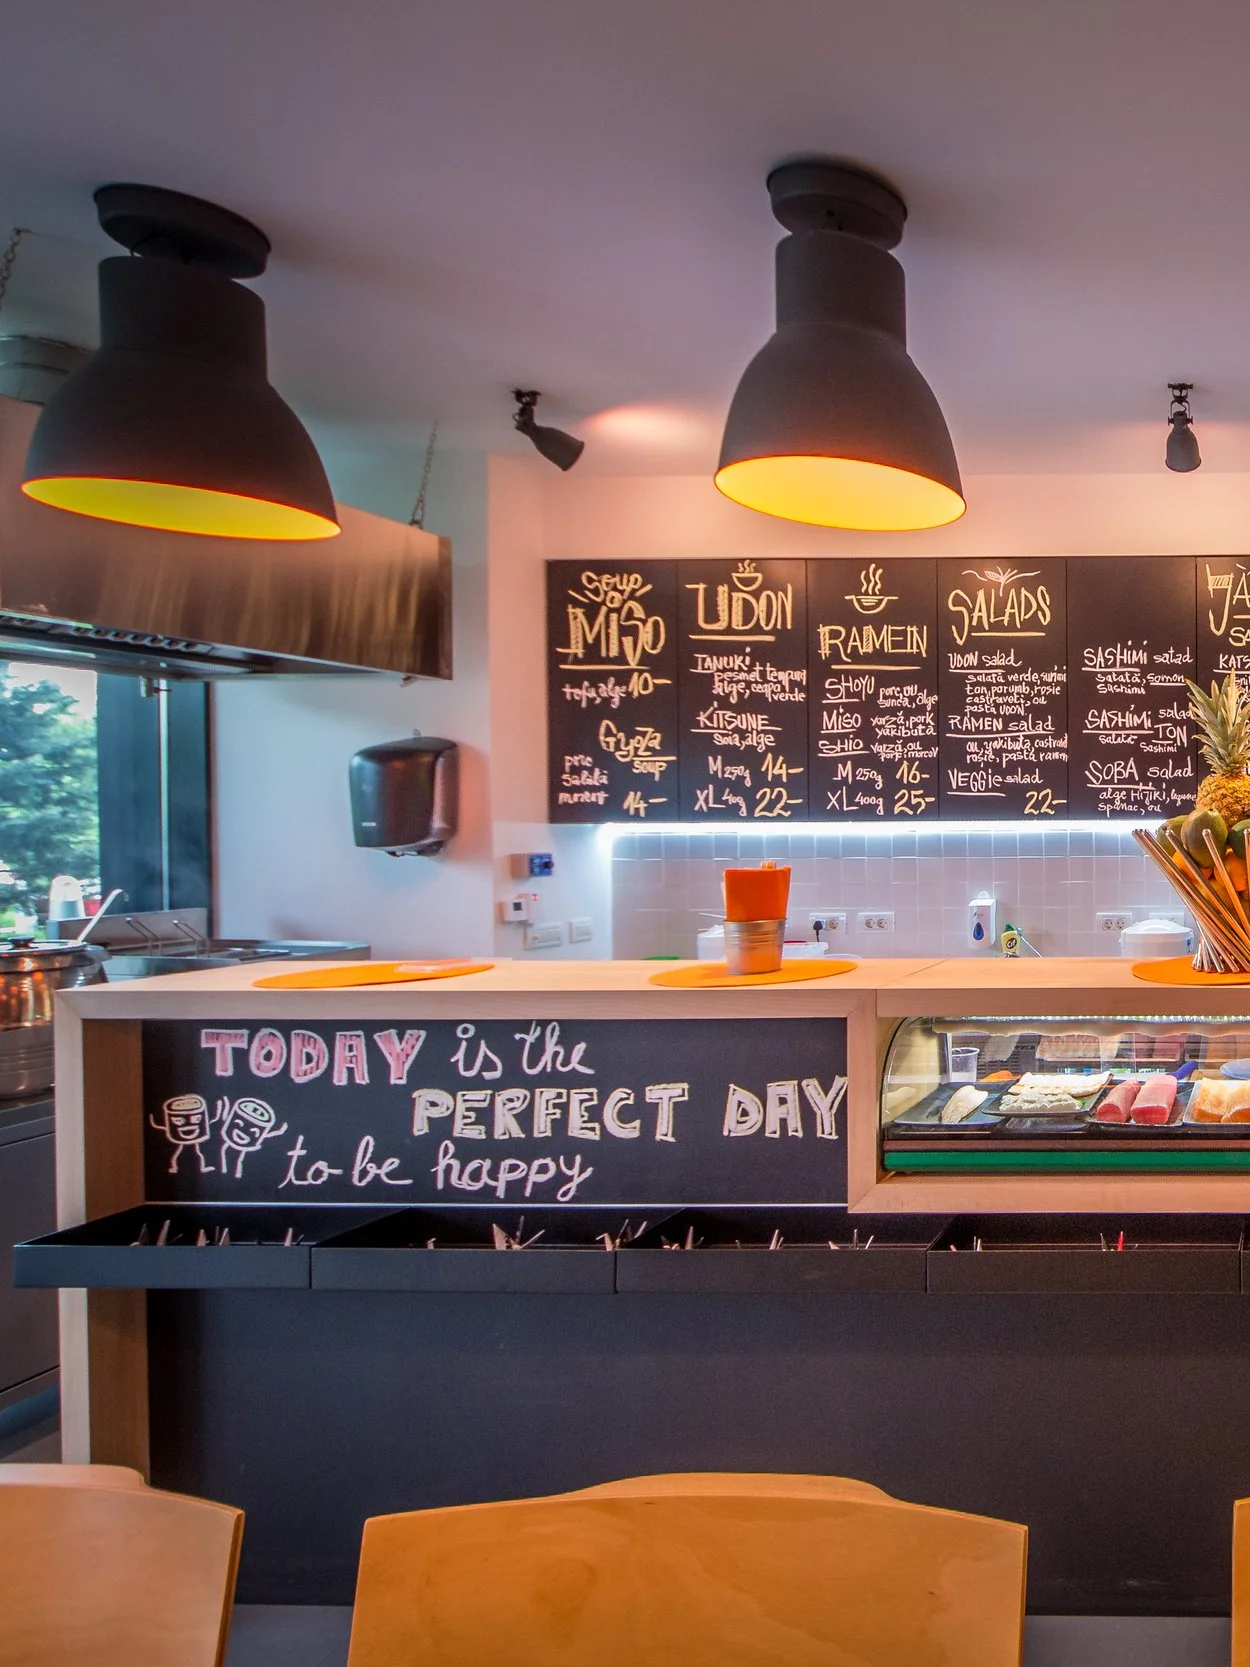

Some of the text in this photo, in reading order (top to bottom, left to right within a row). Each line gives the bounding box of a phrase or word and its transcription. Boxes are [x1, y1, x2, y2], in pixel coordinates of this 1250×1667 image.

[685, 582, 792, 631] UDON
[948, 585, 1051, 646] SALADS
[817, 624, 927, 662] RAMEN
[948, 648, 1022, 669] UDON salad
[825, 674, 875, 701] SHOYU
[948, 713, 1055, 732] RAMEN salad
[1154, 723, 1187, 748] TON
[708, 756, 722, 779] M
[833, 760, 852, 784] M
[856, 768, 883, 790] 250g
[1004, 767, 1043, 784] salad
[1085, 756, 1194, 785] SOBA salad
[695, 784, 726, 812] XL
[827, 786, 859, 811] XL
[855, 792, 884, 815] 400g
[200, 1021, 595, 1086] TODAY is the
[411, 1075, 848, 1142] PERFECT DAY
[278, 1135, 594, 1201] to be happy
